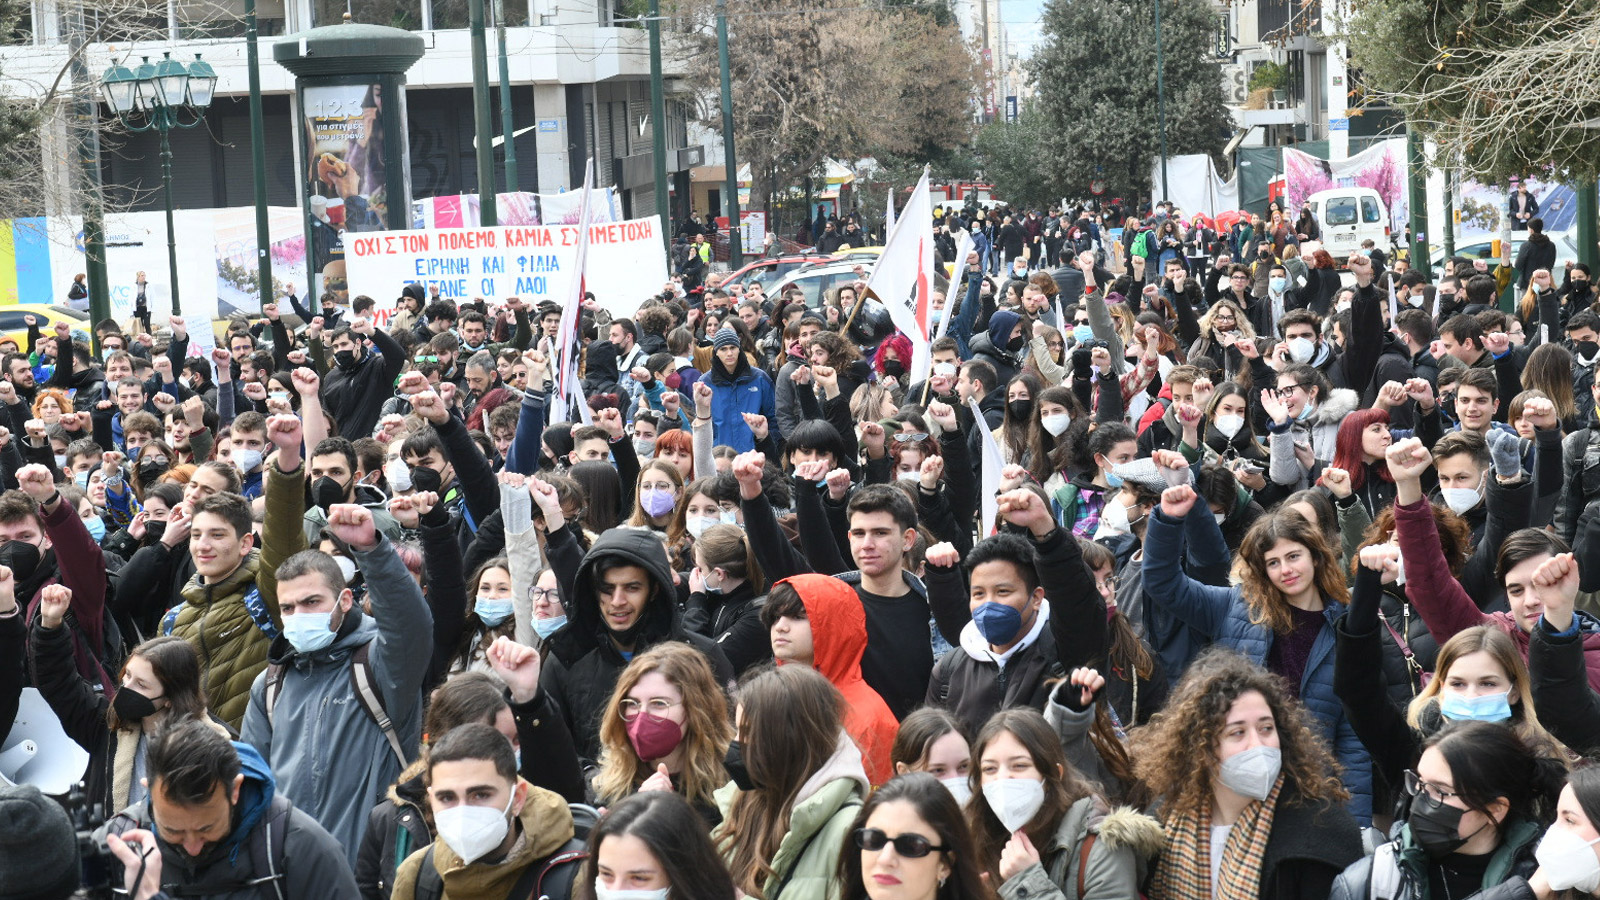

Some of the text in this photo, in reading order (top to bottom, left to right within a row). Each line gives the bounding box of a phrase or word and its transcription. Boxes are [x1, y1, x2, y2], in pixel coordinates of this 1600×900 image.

[316, 121, 364, 132] για στιγμές
[331, 132, 365, 142] μετράνε
[354, 237, 381, 257] ΟΧΙ
[385, 233, 429, 255] ΣΤΟΝ
[505, 228, 553, 248] ΚΑΜΙΑ
[415, 255, 560, 276] ΕΙΡΗΝΗ ΚΑΙ ΦΙΛΙΑ
[481, 278, 495, 296] ΟΙ
[515, 276, 547, 295] ΛΑΟΙ
